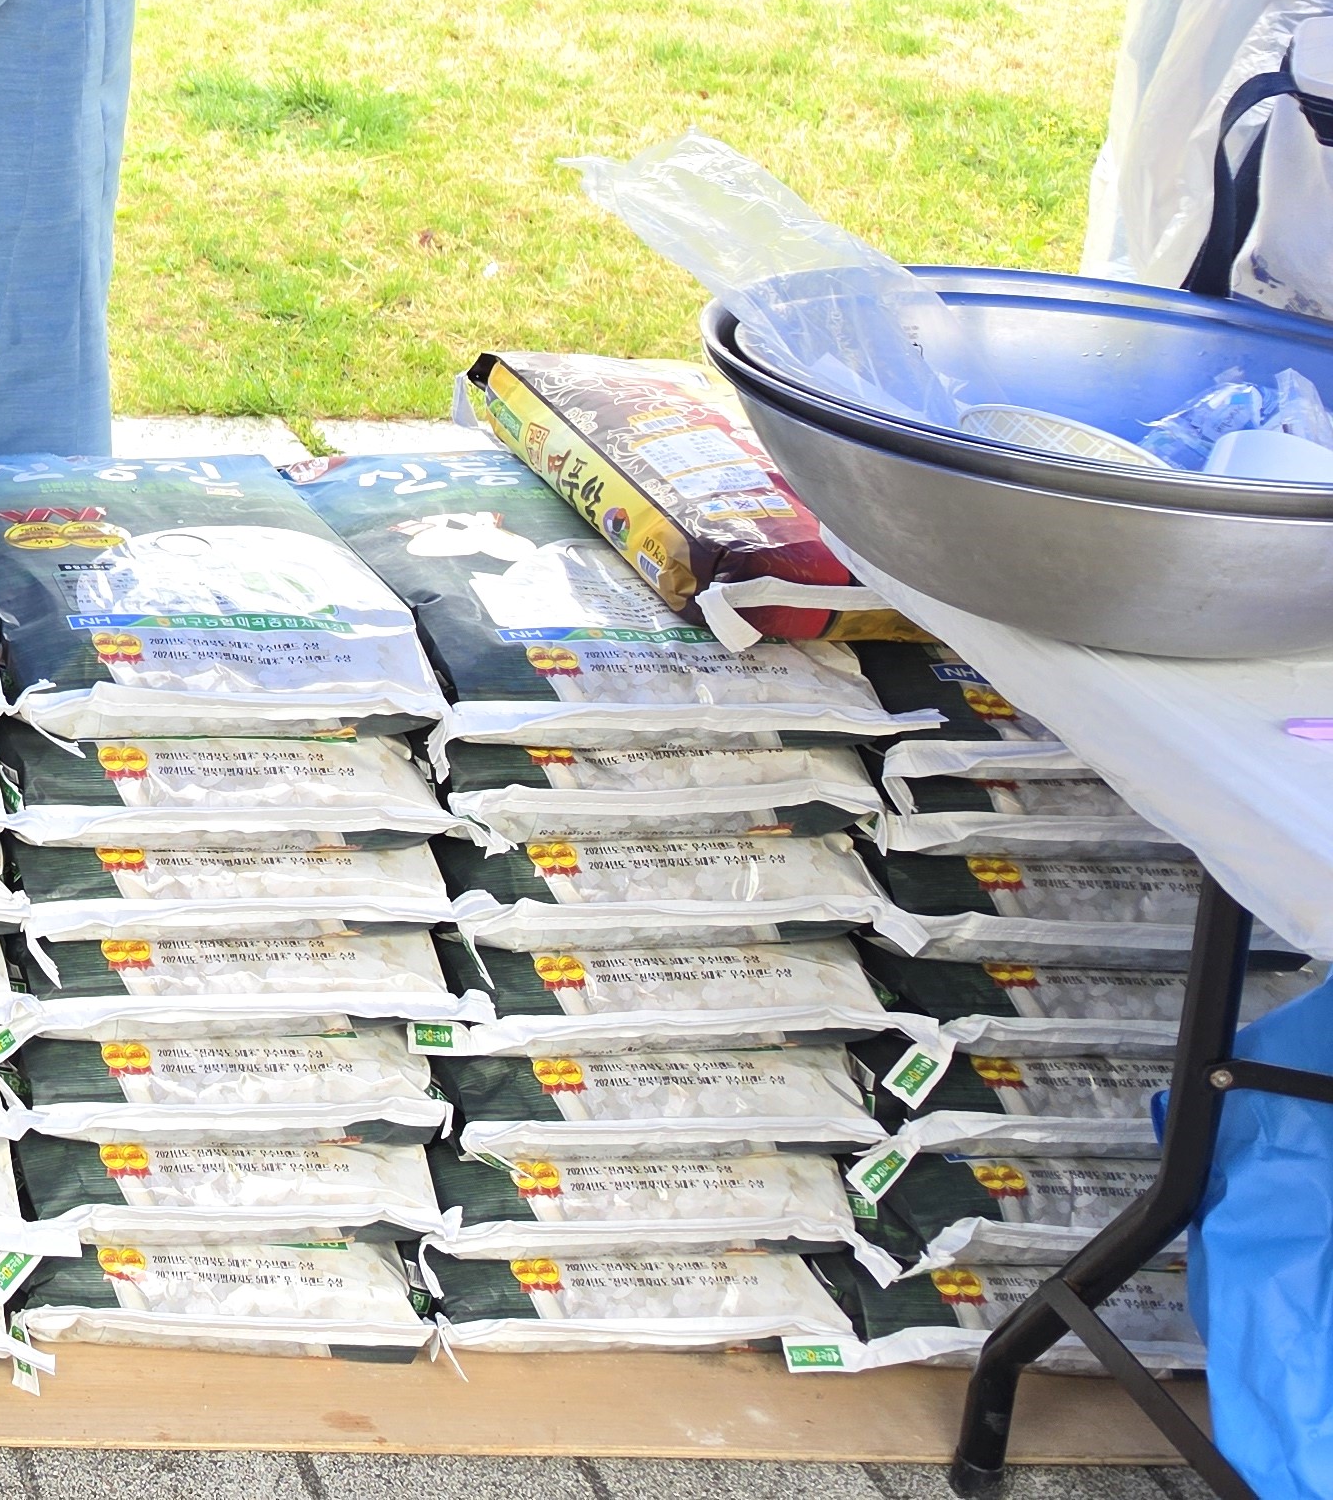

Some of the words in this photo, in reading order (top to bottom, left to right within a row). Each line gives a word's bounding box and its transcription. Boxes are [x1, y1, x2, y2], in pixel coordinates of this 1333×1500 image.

[78, 615, 113, 628] NH
[507, 629, 544, 641] NH
[944, 665, 979, 680] NH
